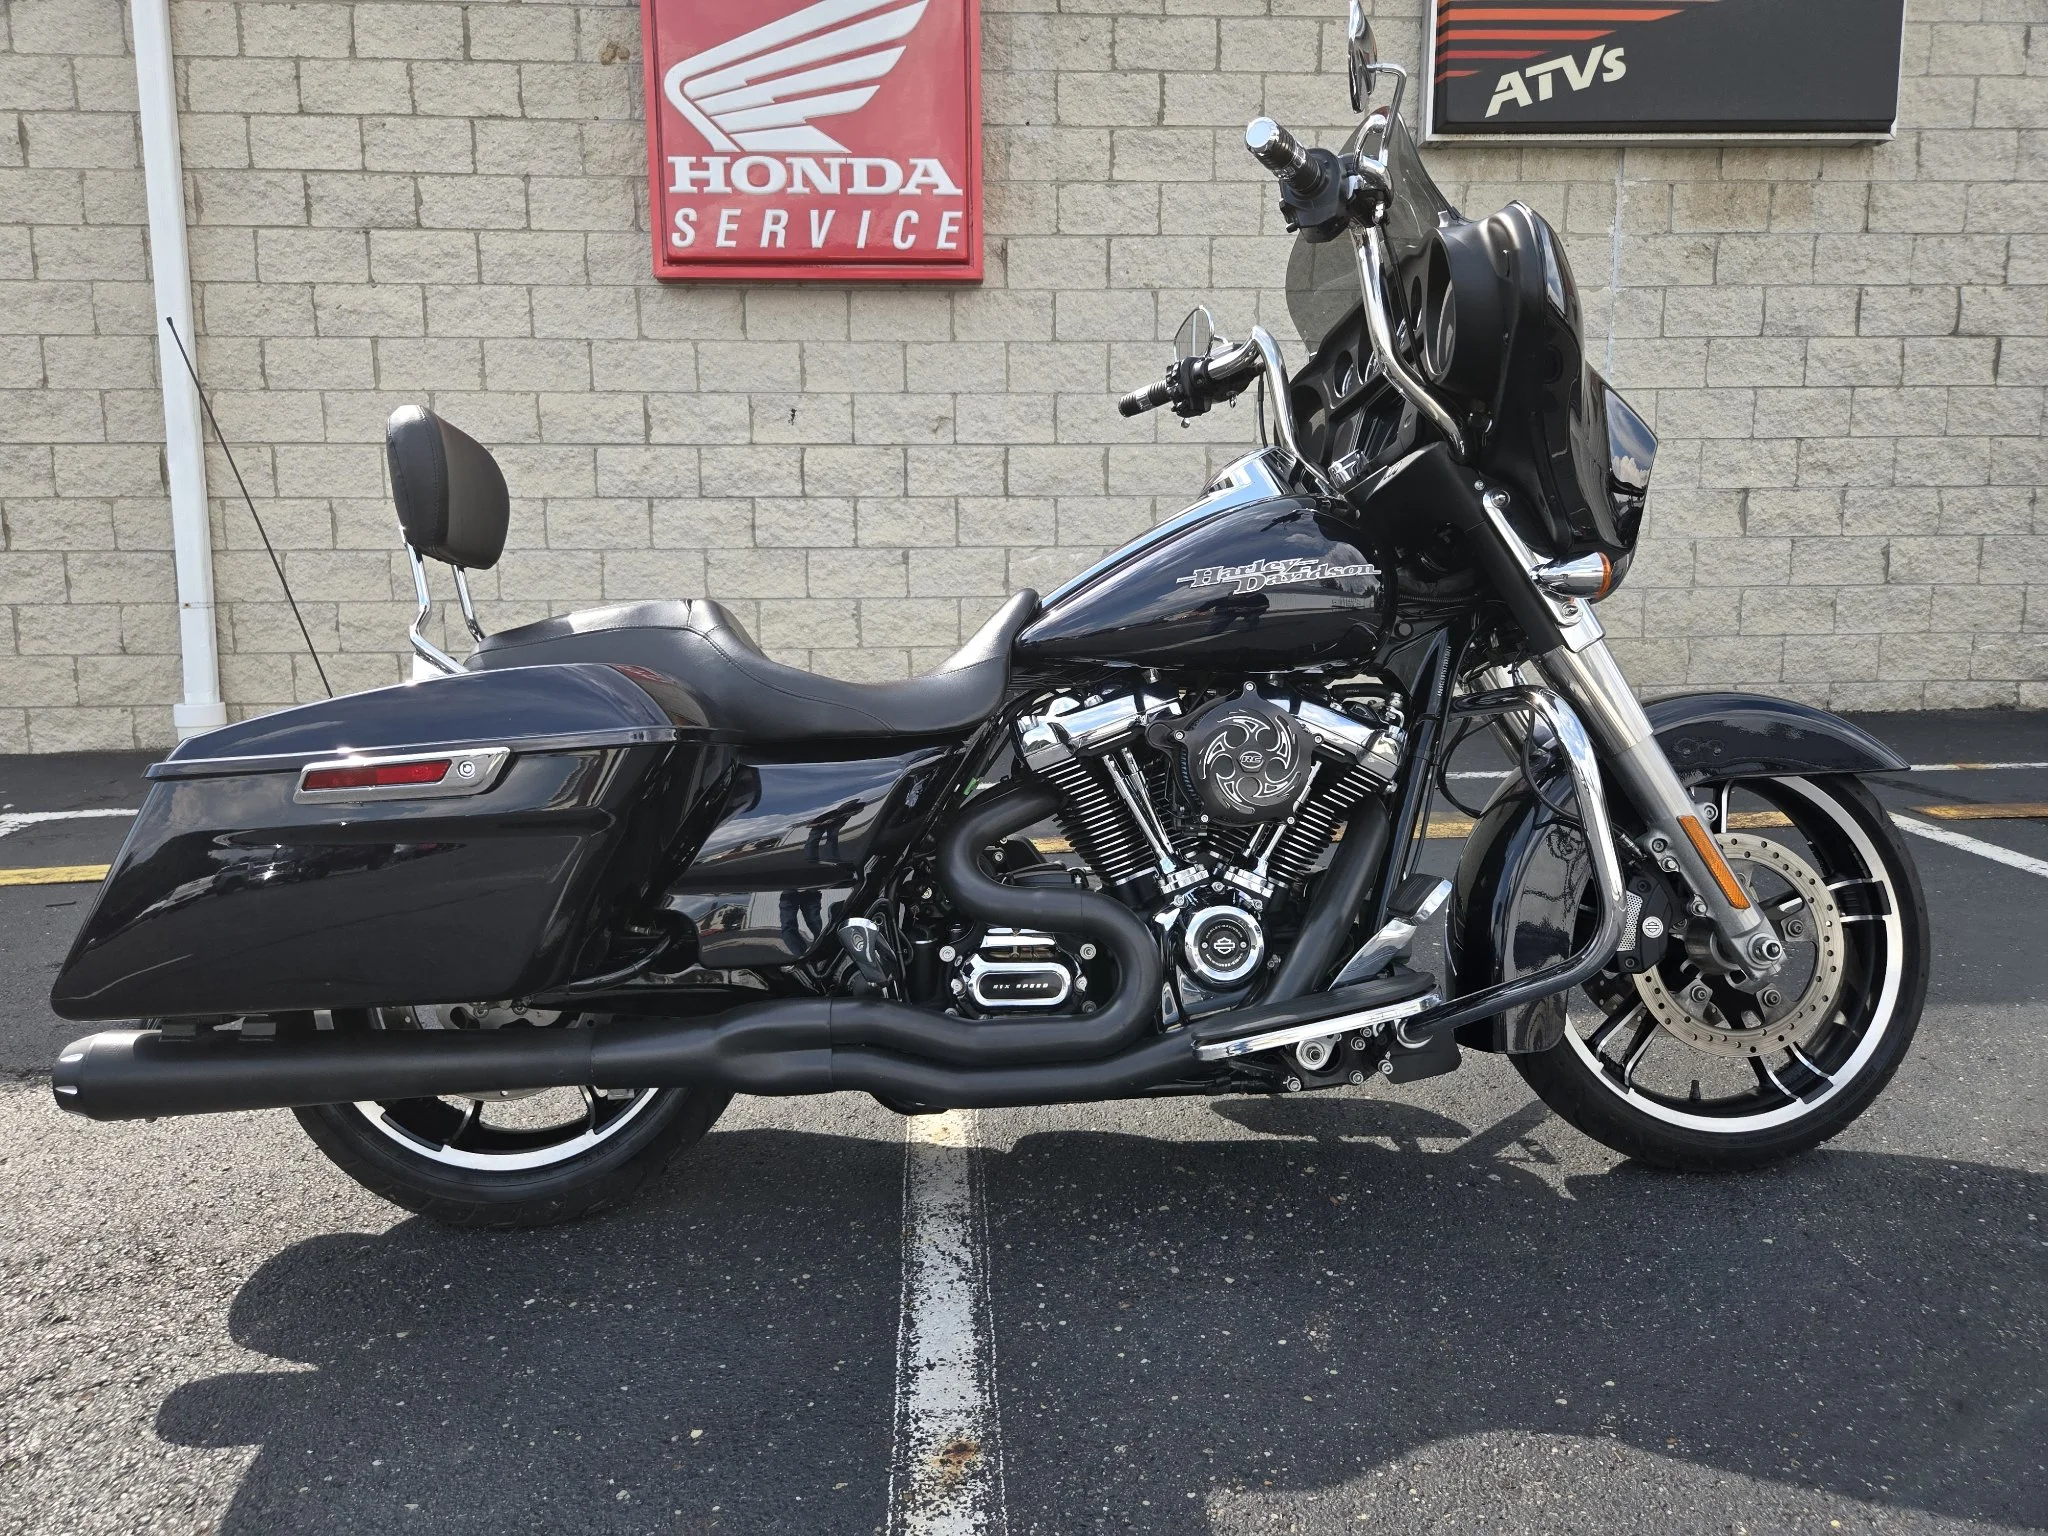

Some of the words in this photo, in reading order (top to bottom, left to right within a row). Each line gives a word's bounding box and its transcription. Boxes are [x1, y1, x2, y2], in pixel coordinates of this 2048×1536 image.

[1484, 44, 1626, 118] ATVs
[667, 155, 963, 196] HONDA
[671, 207, 963, 250] SERVICE
[1233, 563, 1382, 595] Davidson
